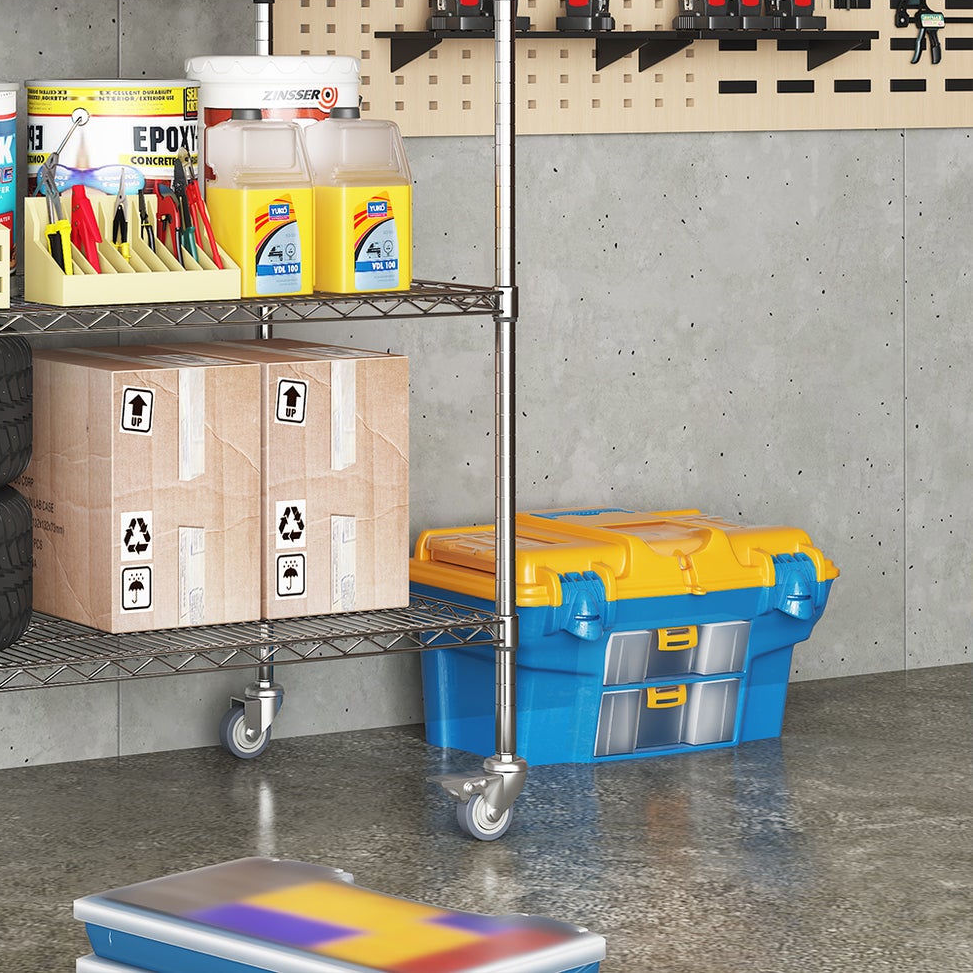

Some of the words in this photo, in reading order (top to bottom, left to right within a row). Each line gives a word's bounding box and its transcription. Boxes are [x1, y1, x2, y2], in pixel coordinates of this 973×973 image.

[262, 89, 321, 101] ZINSSER
[273, 265, 286, 274] VDL
[287, 264, 298, 273] 100
[371, 262, 384, 270] VDL
[385, 261, 396, 269] 100
[285, 408, 296, 418] UP
[131, 417, 142, 427] UP
